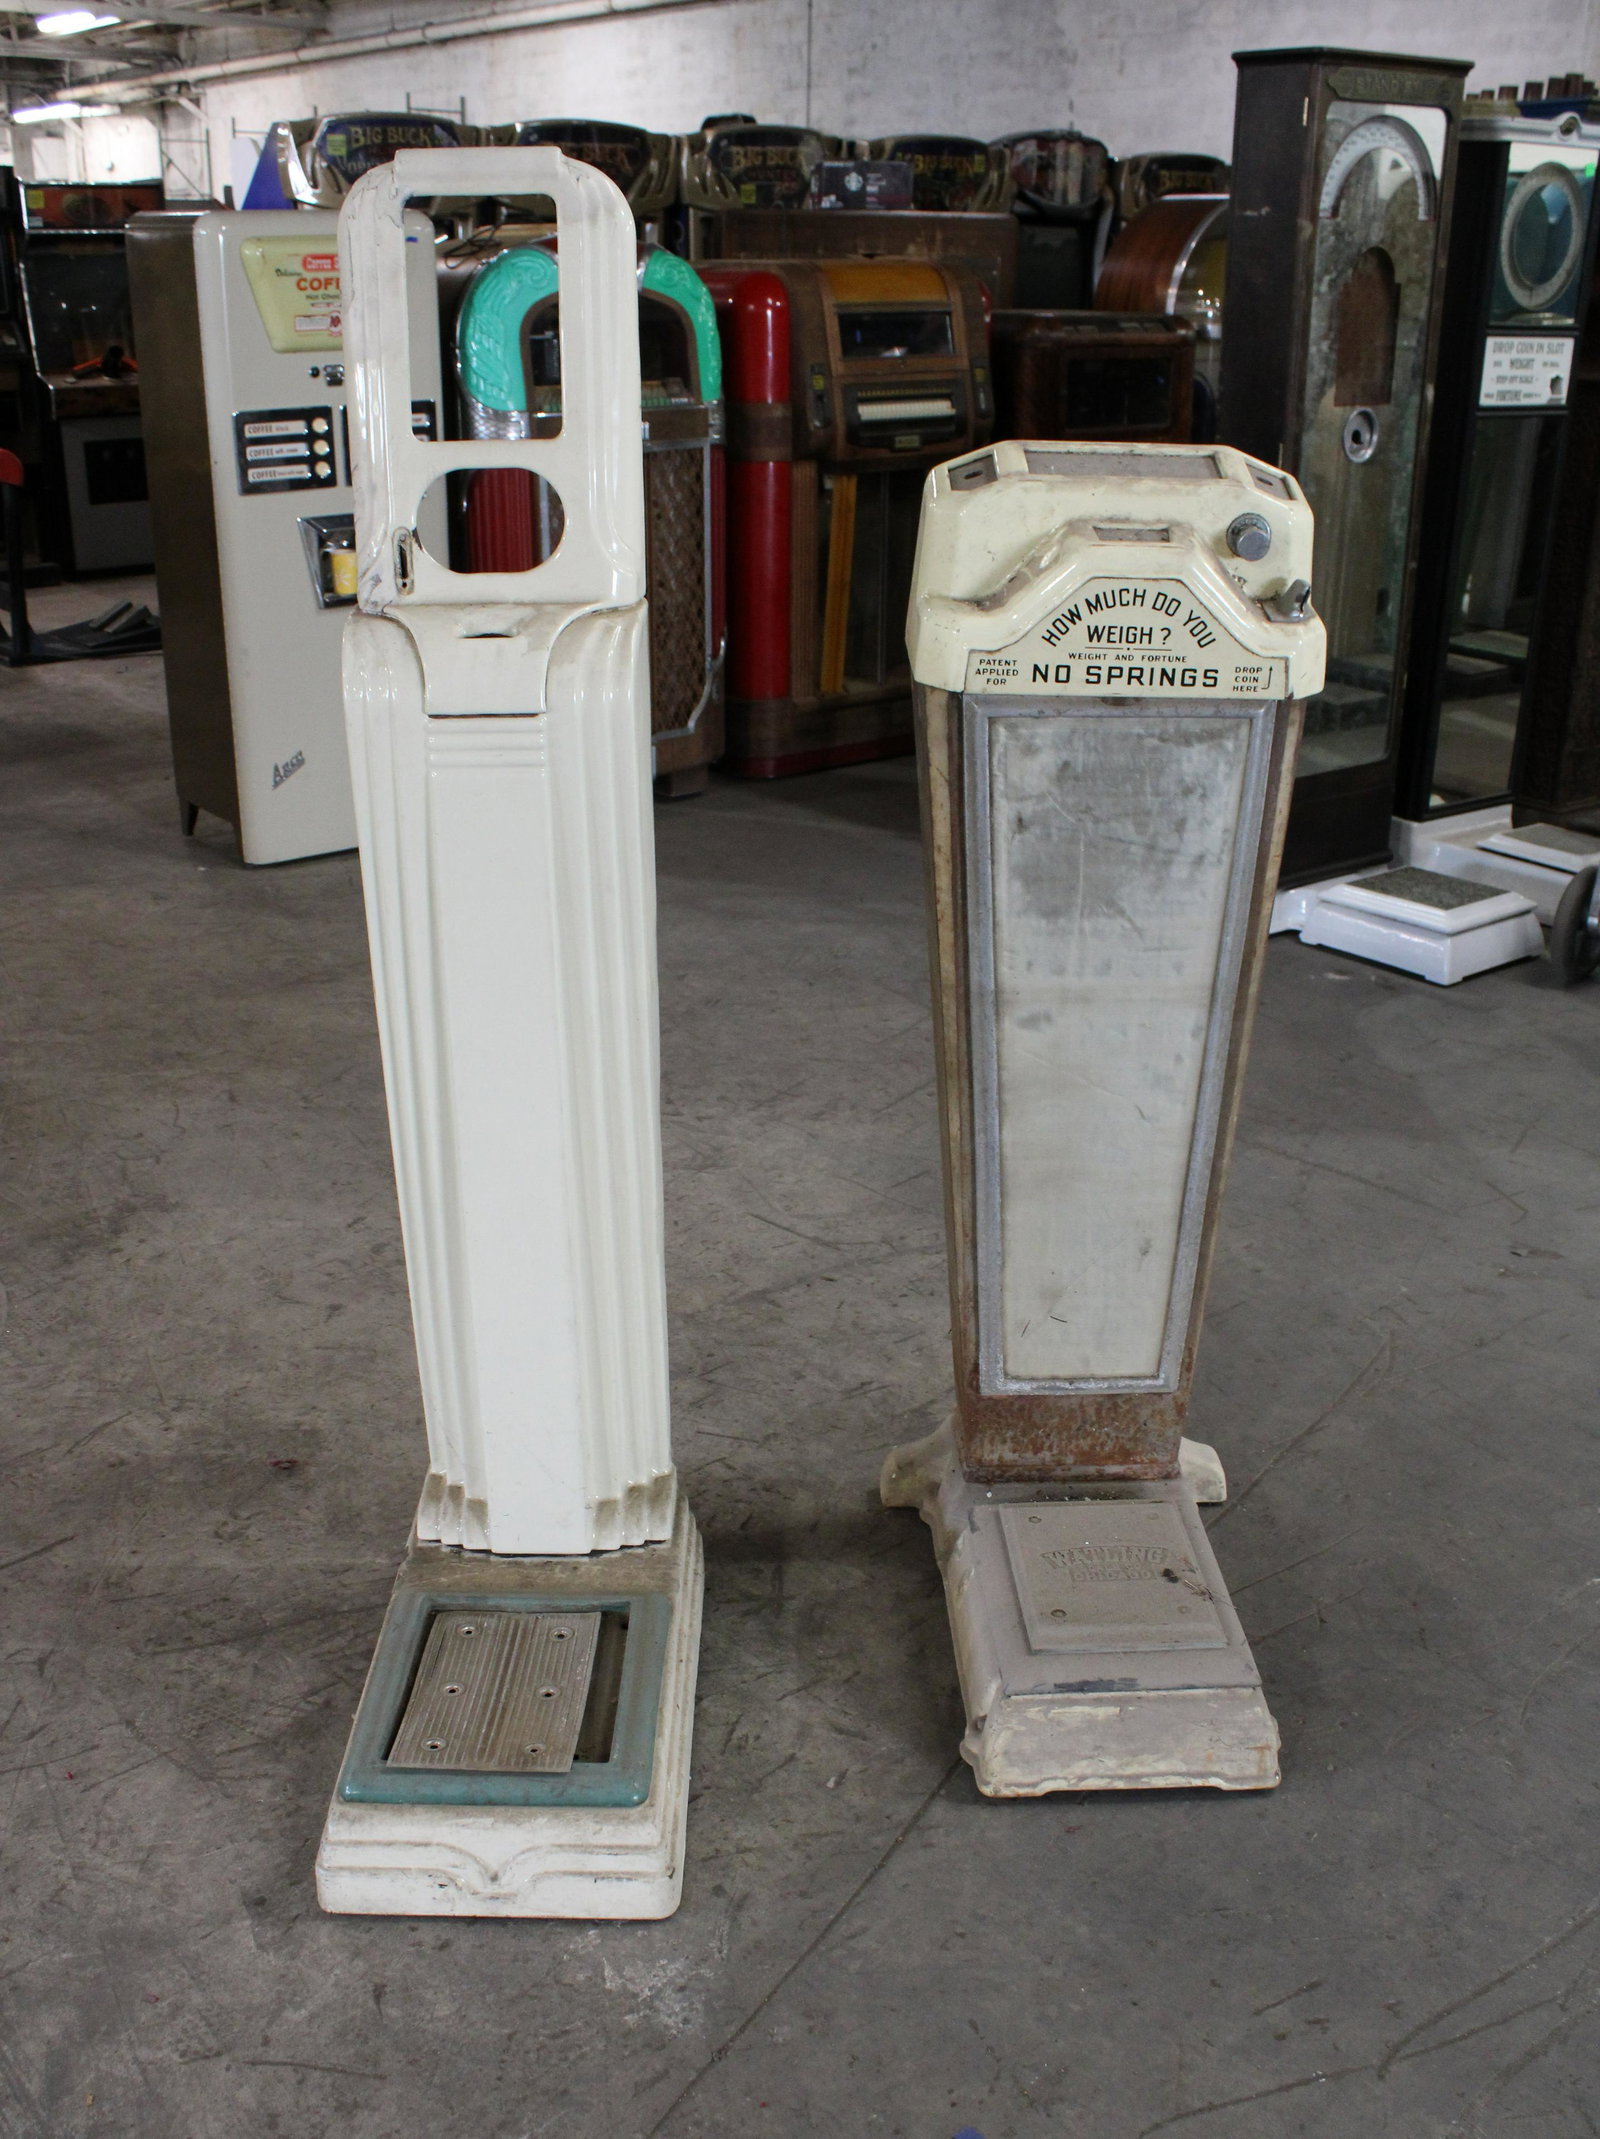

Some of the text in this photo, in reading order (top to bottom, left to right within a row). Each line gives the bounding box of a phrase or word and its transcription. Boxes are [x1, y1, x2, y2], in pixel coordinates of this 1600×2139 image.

[351, 127, 382, 147] BIG
[388, 126, 432, 147] BUCK
[1493, 341, 1515, 354] DROP
[1546, 342, 1565, 354] SLOT
[248, 425, 273, 434] COFFEE
[249, 448, 274, 457] COFFEE
[251, 470, 276, 479] COFFEE
[1041, 588, 1216, 648] HOW MUCH DO YOU
[1068, 652, 1187, 663] WEIGHT AND FORTUNE
[979, 658, 1017, 667] PATENT
[975, 668, 1019, 677] APPLIED
[1235, 666, 1262, 674] DROP
[1032, 663, 1219, 688] NO SPRINGS
[1234, 675, 1259, 683] COIN
[1043, 1547, 1164, 1567] WATLING
